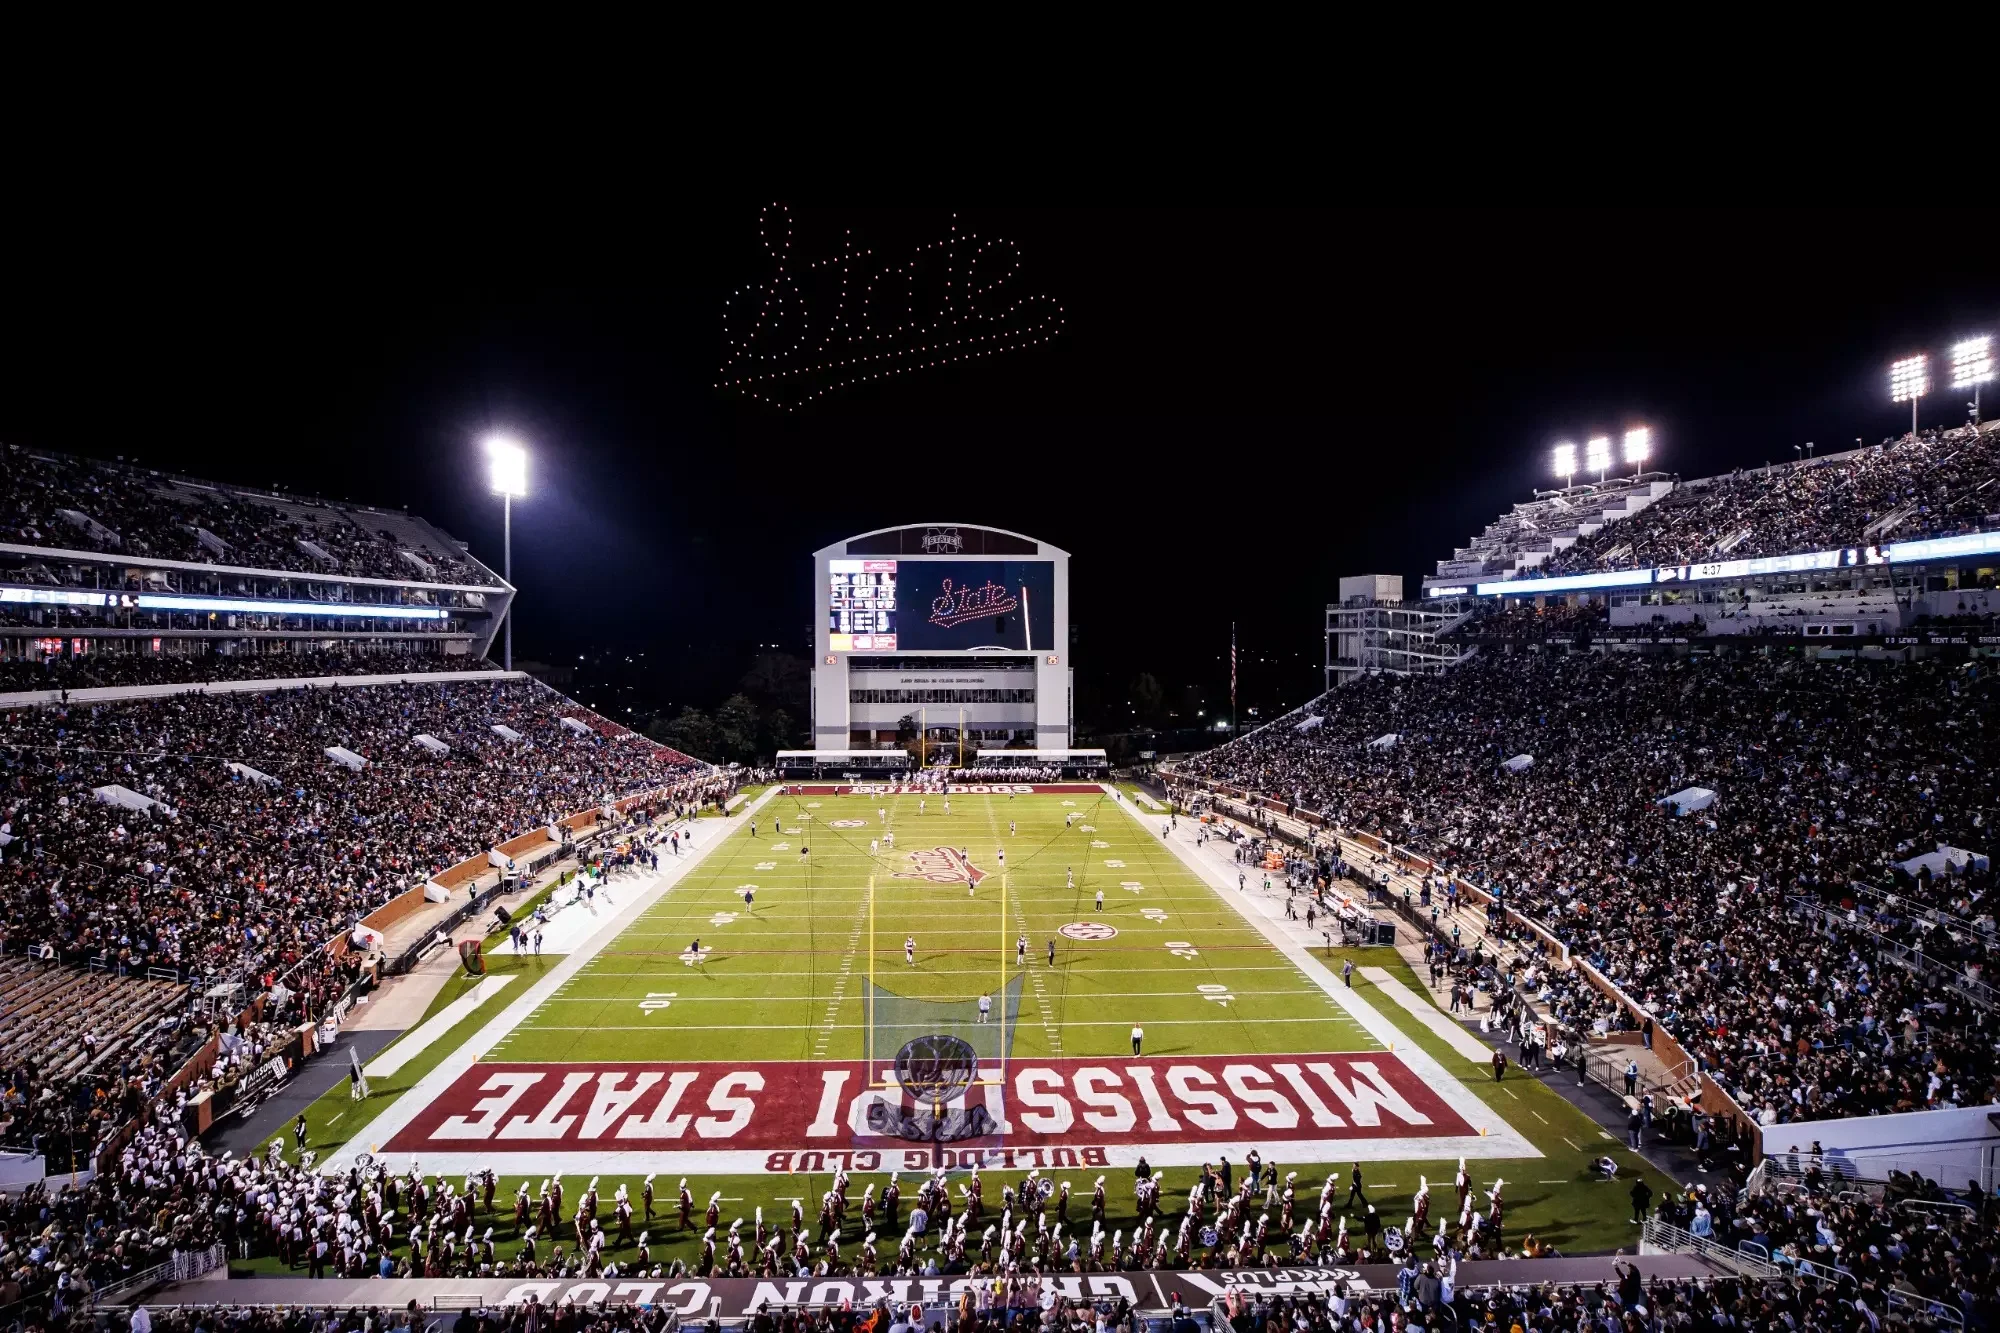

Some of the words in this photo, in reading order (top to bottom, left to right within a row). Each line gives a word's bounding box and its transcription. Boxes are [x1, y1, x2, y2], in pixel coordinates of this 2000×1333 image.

[714, 202, 1064, 408] State
[929, 536, 956, 545] STATE
[1702, 565, 1721, 576] 4:37
[929, 579, 1017, 628] State
[1164, 941, 1199, 956] 20
[638, 992, 678, 1009] 10
[1196, 984, 1236, 1001] 10
[429, 1070, 766, 1140] STATE
[806, 1062, 1434, 1138] MISSISSIPPI
[764, 1150, 882, 1171] CLUB
[903, 1146, 1111, 1170] BULLDOG
[1220, 1270, 1293, 1285] PLUS
[741, 1275, 1138, 1315] GRDIRON
